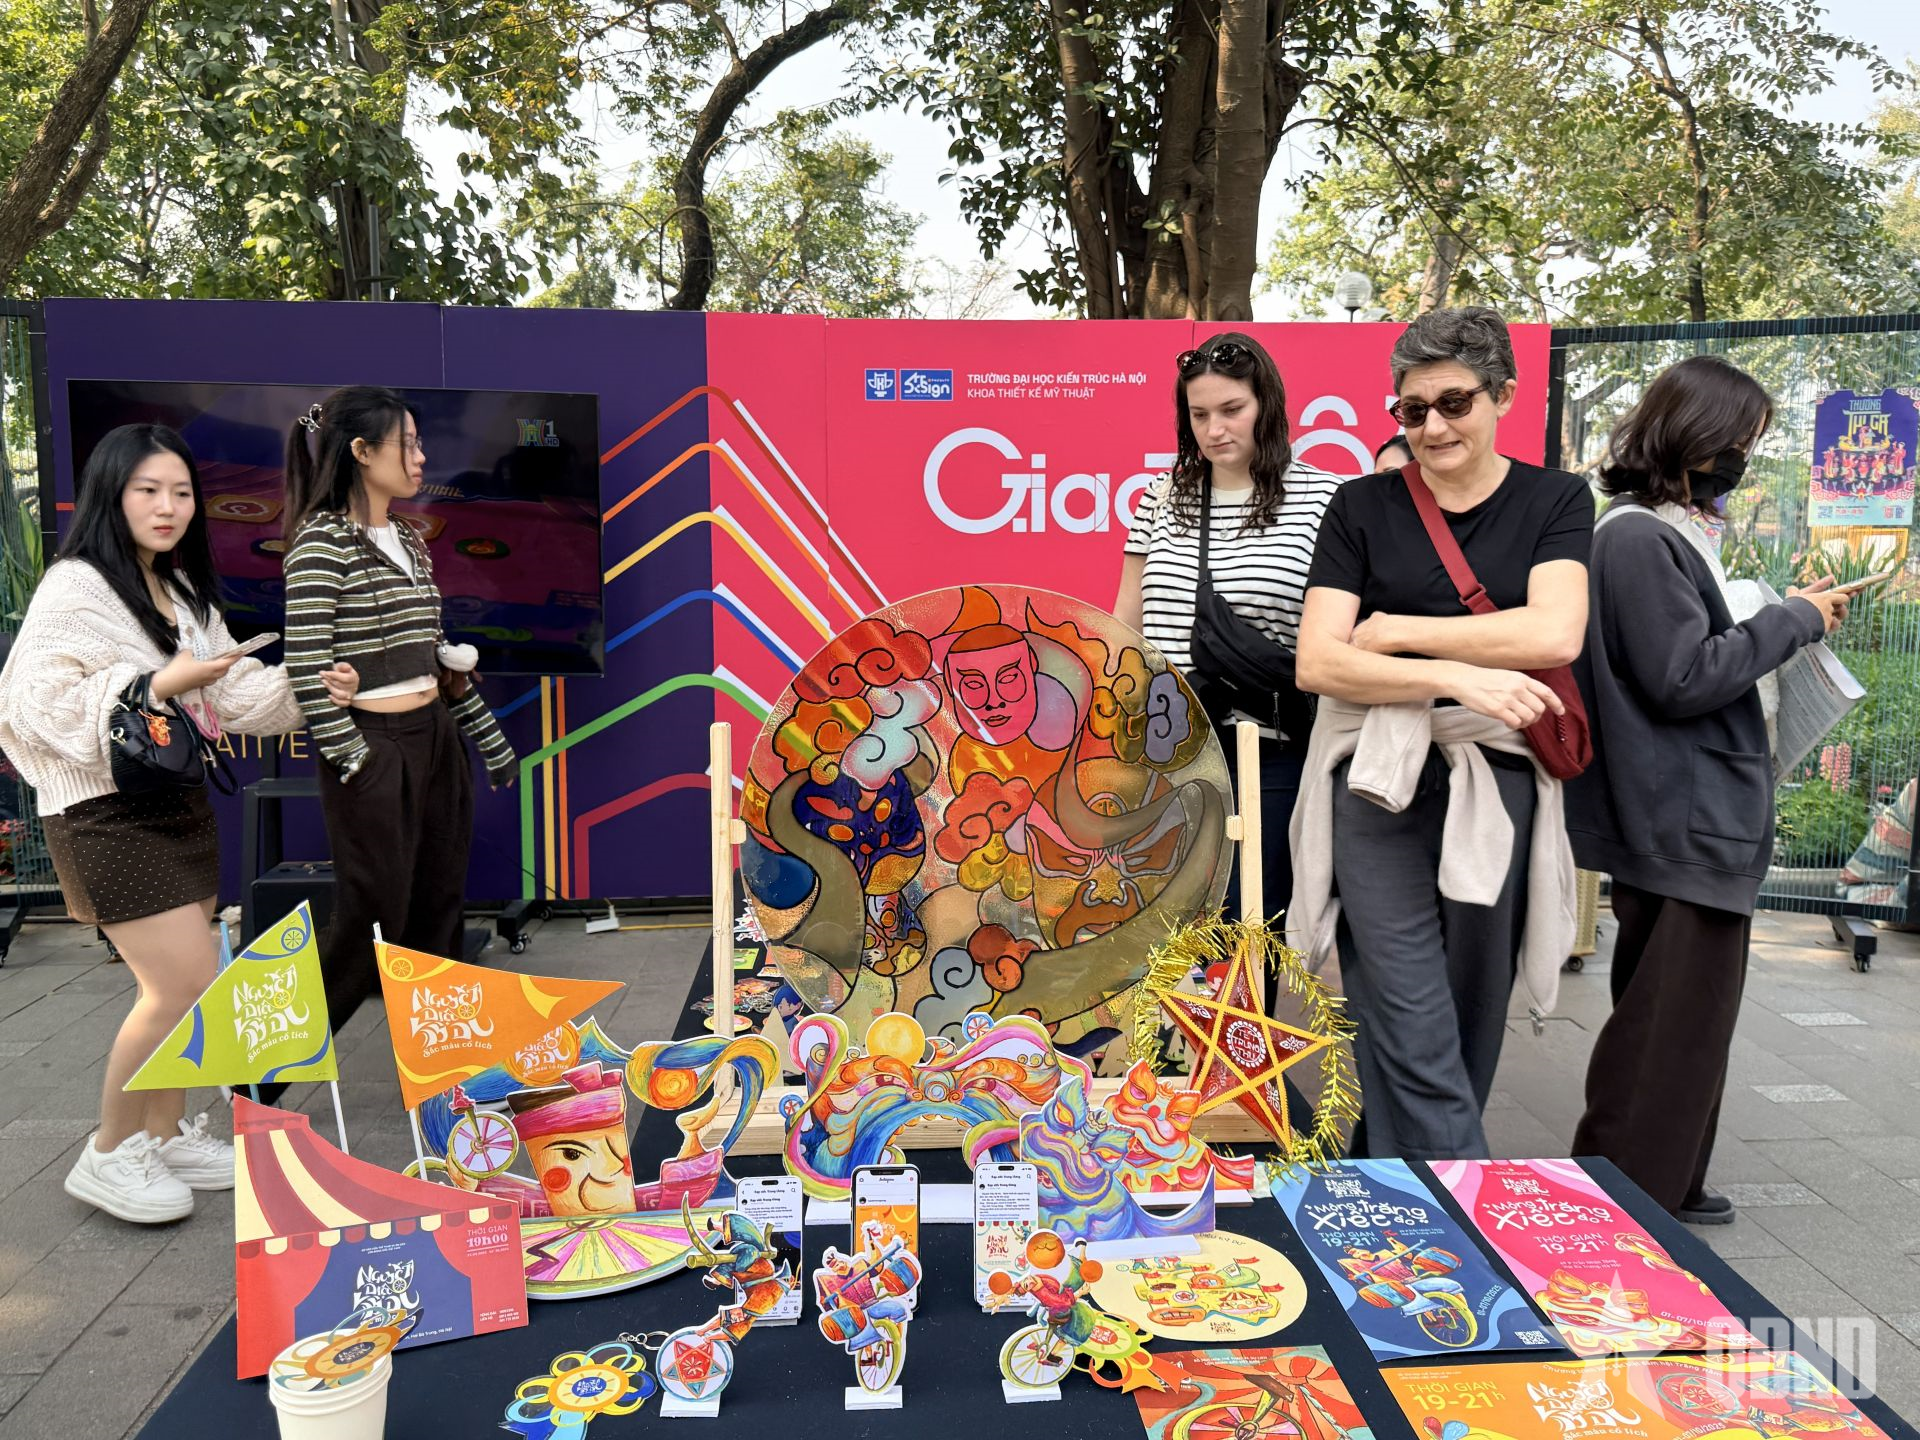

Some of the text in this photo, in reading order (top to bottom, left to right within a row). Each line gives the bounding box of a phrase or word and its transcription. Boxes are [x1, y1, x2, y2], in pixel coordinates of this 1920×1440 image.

[967, 371, 1147, 385] TRƯỜNG ĐẠI HỌC KIẾN TRÚC HÀ NỘI
[967, 386, 1095, 400] KHOA THIẾT KẾ MỸ THUẬT
[488, 1224, 508, 1234] GIAN
[1347, 1230, 1376, 1238] GIAN
[466, 1232, 508, 1248] 19h00
[1571, 1233, 1604, 1243] GIAN
[1407, 1381, 1498, 1394] THỜI GIAN
